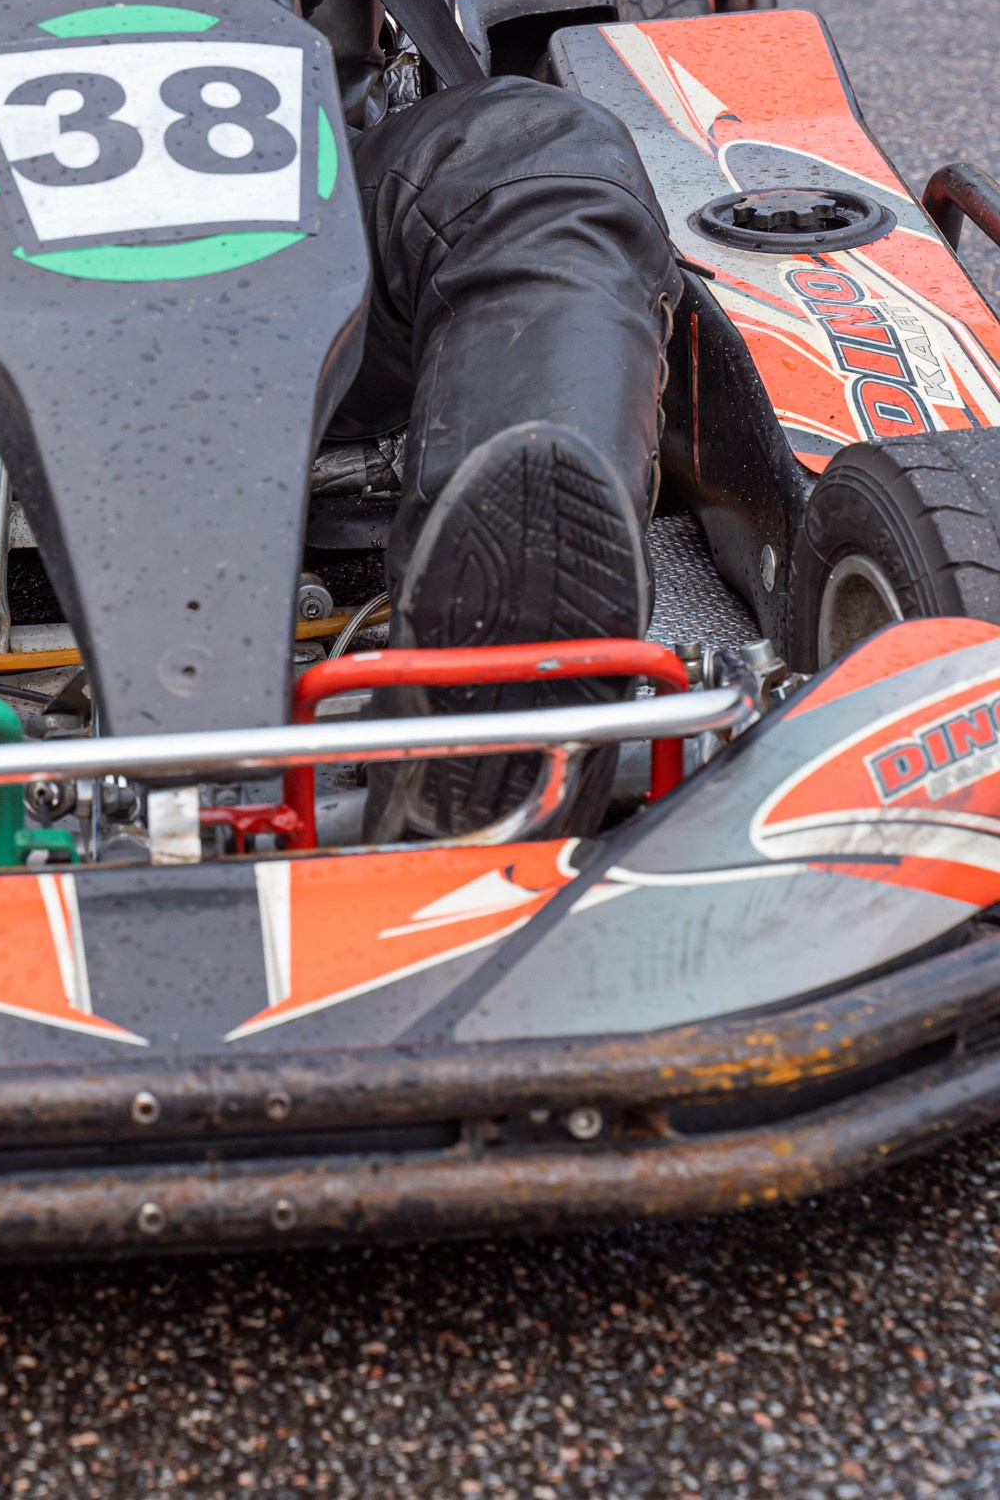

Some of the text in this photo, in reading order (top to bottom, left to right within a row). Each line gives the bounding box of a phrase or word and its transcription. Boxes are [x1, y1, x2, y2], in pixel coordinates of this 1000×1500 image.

[4, 65, 298, 187] 38
[785, 268, 937, 439] DINO
[878, 301, 955, 401] KART
[870, 698, 1000, 798] DIN
